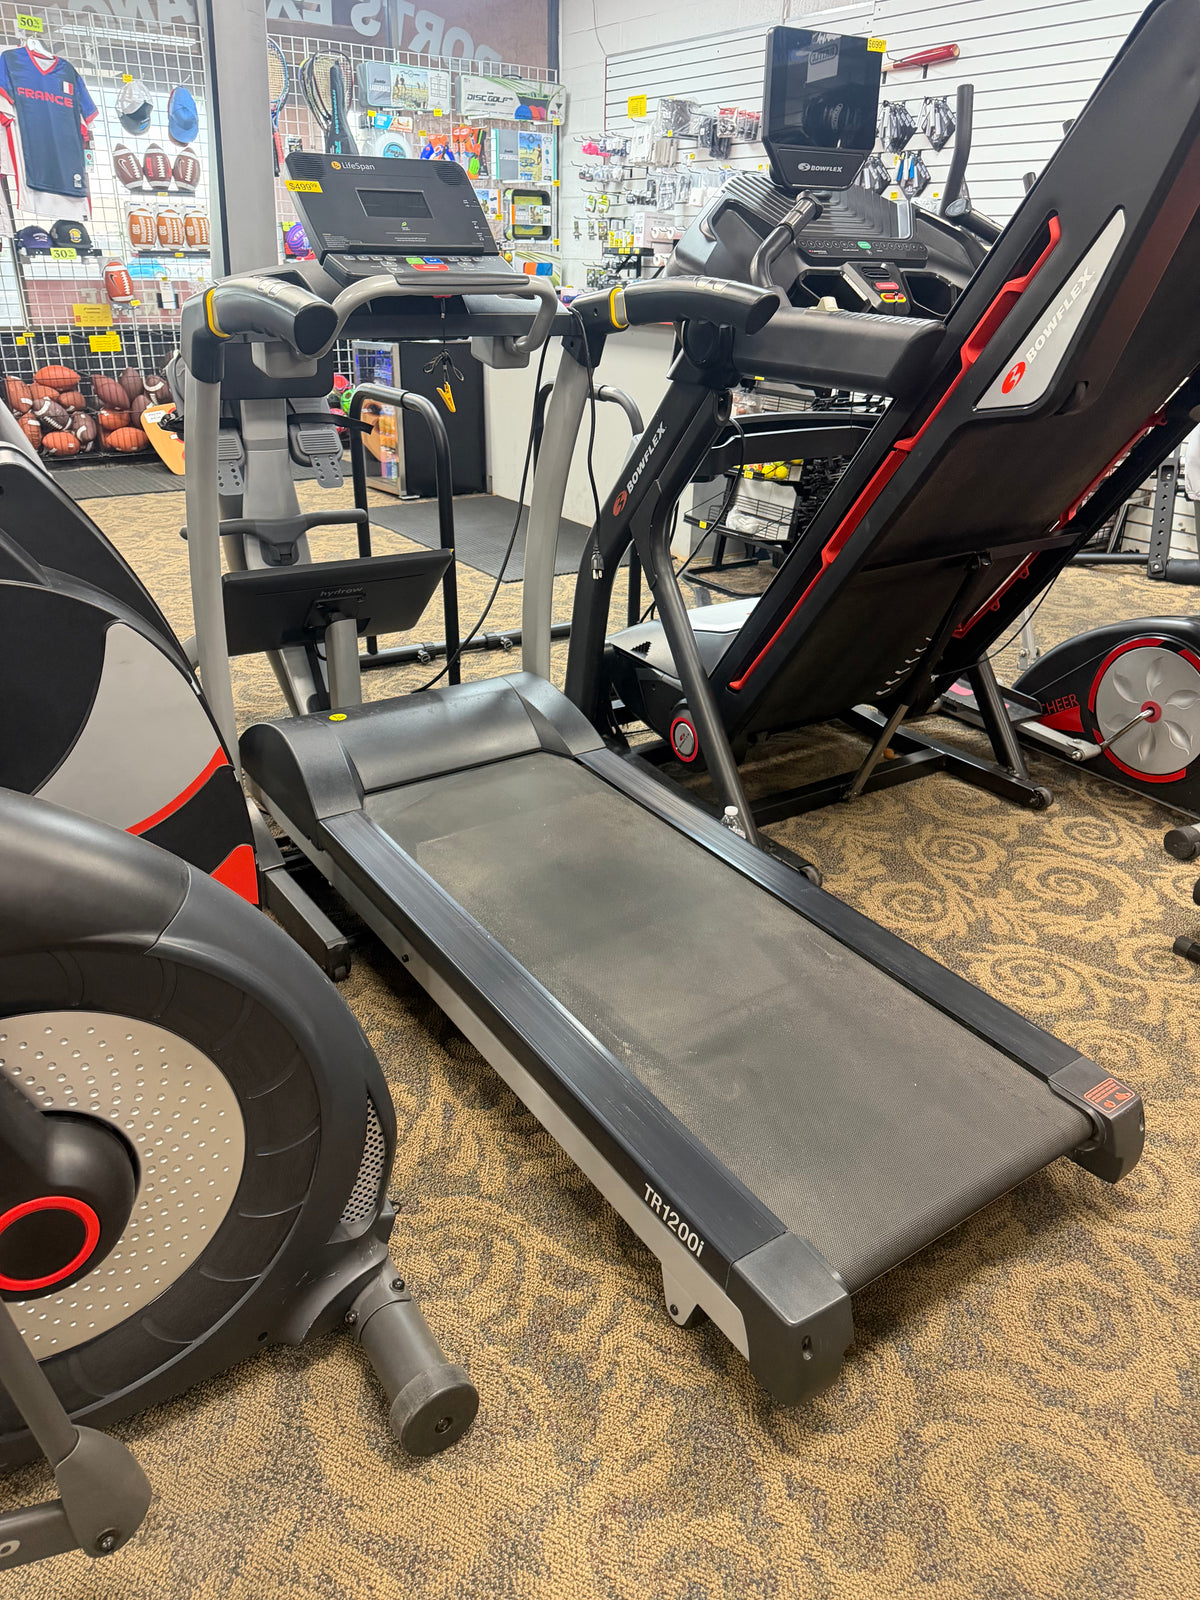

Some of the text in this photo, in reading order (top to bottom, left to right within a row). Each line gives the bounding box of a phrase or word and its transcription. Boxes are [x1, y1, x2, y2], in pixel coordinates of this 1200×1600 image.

[17, 87, 74, 108] FRANCE
[467, 93, 488, 102] DISC
[341, 162, 376, 171] LifeSpan
[811, 164, 843, 173] BOWFLEX
[1025, 266, 1095, 364] BOWFLEX
[626, 421, 667, 495] BOWFLEX
[320, 587, 363, 597] hydrow
[644, 1182, 705, 1258] TR1200i
